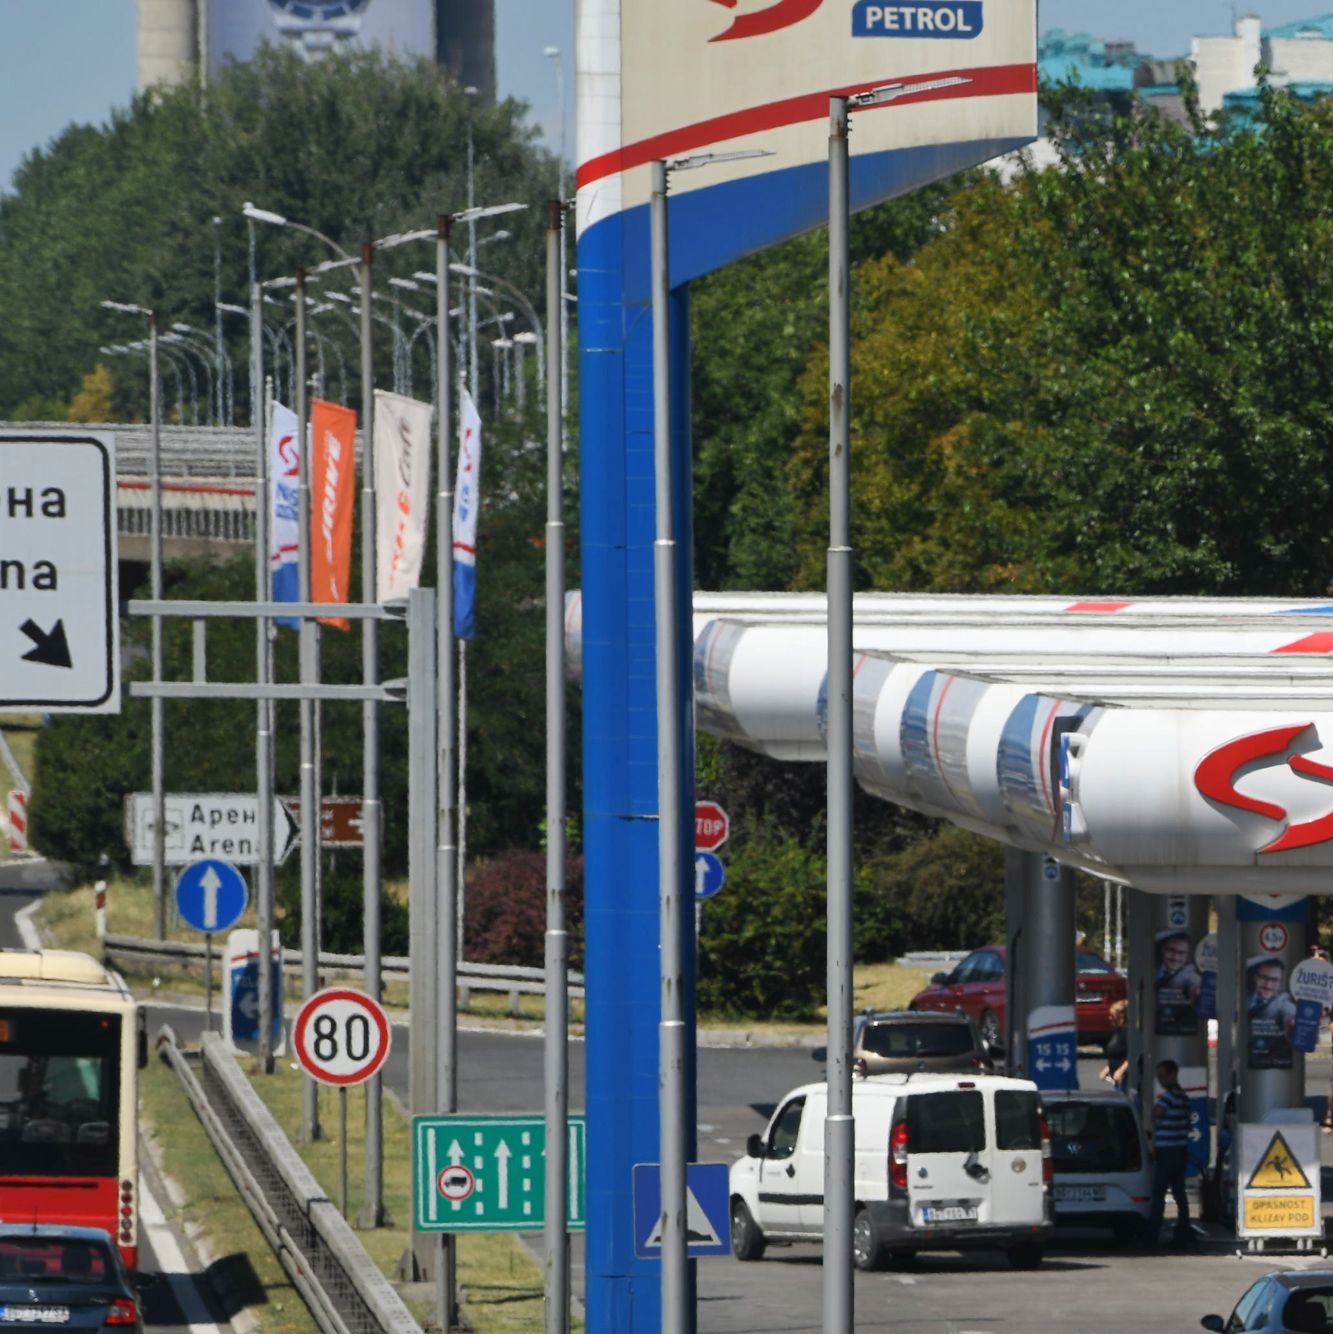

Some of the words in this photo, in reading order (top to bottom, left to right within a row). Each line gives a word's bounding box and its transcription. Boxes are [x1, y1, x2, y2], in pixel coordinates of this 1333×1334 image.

[866, 6, 973, 31] PETROL
[0, 486, 66, 518] на
[0, 559, 57, 591] na
[191, 804, 257, 827] Арен
[695, 818, 723, 836] TOP
[191, 834, 259, 854] Aren
[313, 1013, 371, 1063] 80
[1037, 1043, 1050, 1056] 15
[1056, 1043, 1070, 1056] 15
